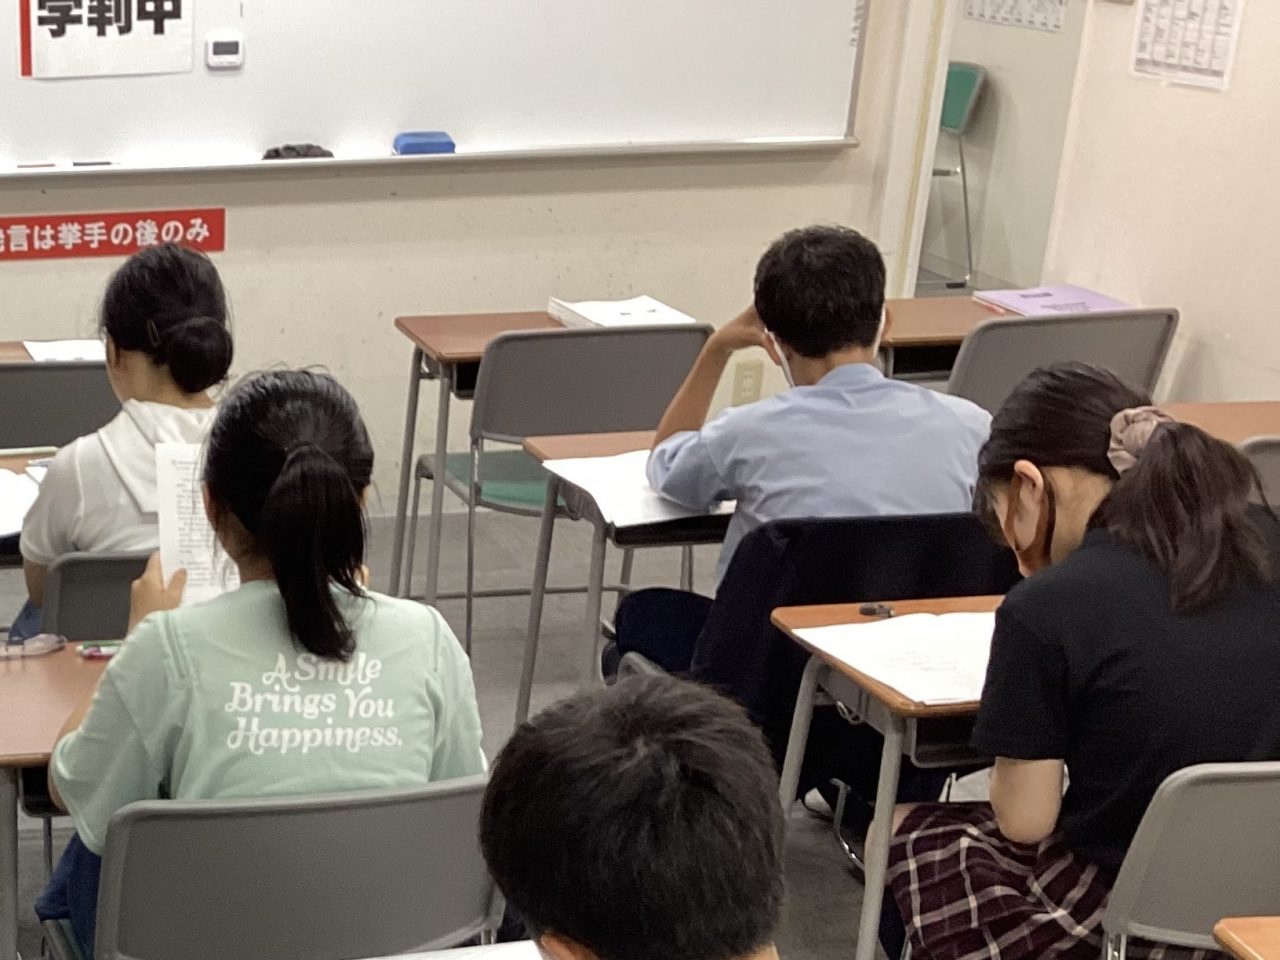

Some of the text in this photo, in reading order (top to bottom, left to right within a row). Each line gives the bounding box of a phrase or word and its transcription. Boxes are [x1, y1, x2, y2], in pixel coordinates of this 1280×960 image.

[262, 652, 382, 692] A Smile
[225, 682, 394, 719] Brings You
[228, 716, 402, 755] Happiness.
